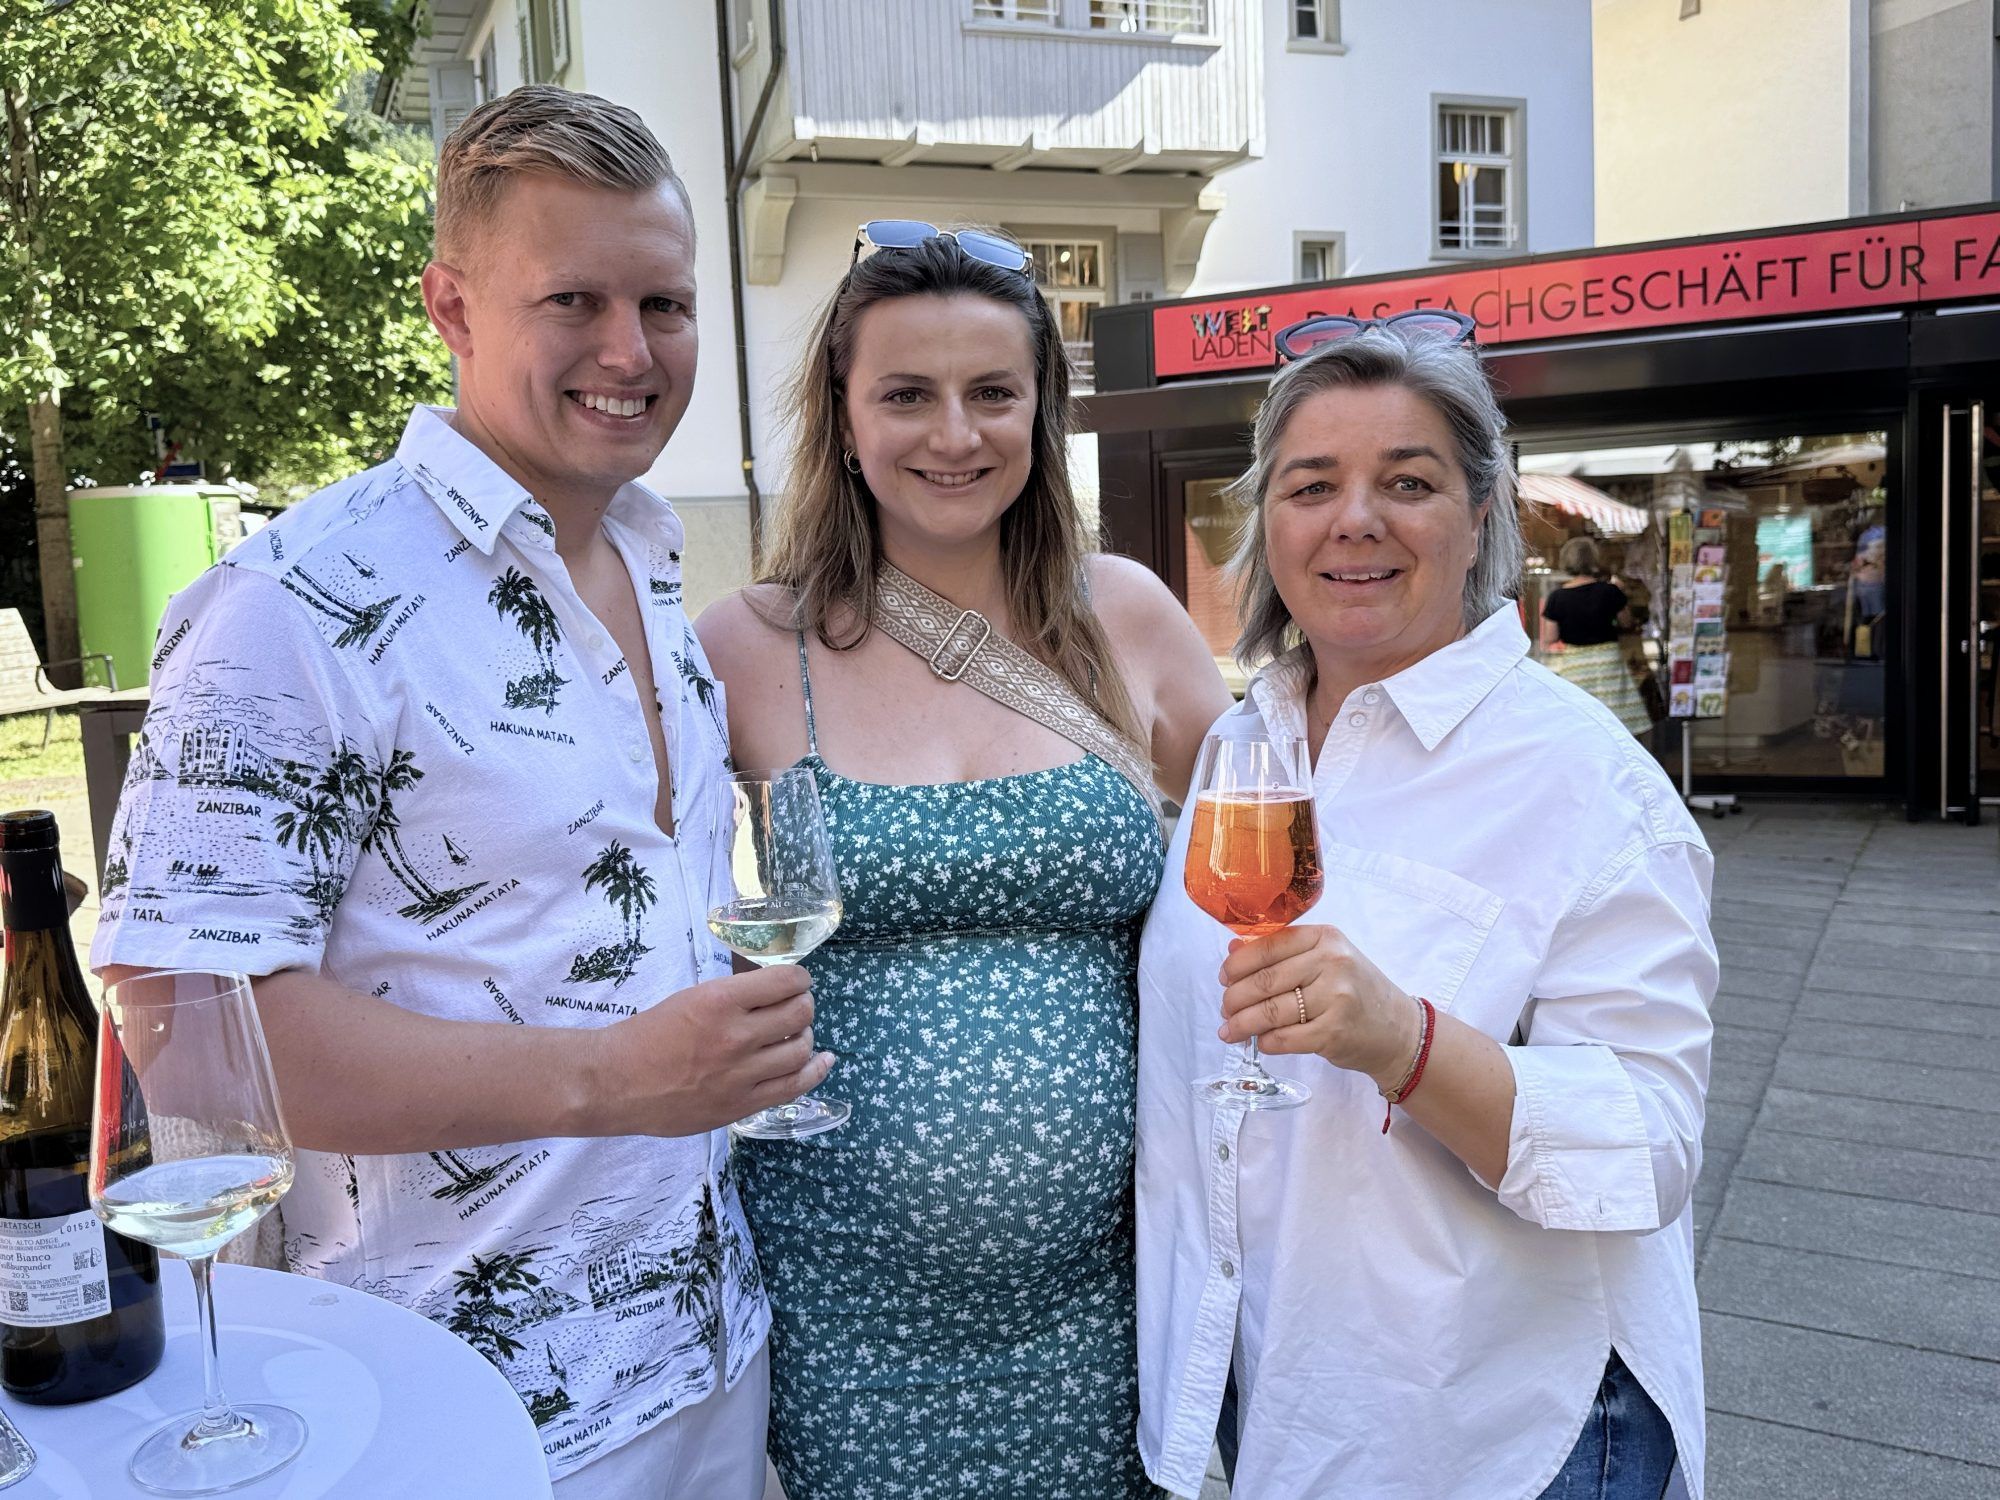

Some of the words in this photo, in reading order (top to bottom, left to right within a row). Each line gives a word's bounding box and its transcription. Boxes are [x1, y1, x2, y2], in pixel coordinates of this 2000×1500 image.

[1830, 236, 1927, 294] FÜR
[1191, 305, 1272, 337] WELT
[1192, 330, 1272, 361] LADEN
[446, 486, 489, 532] ZANZIBAR
[152, 618, 193, 670] ZANZIBAR
[425, 701, 476, 756] ZANZIBAR
[490, 720, 536, 738] HAKUNA
[536, 730, 576, 746] MATATA
[196, 800, 262, 818] ZANZIBAR
[567, 799, 605, 836] ZANZIBAR
[132, 908, 163, 922] TATA
[426, 905, 476, 942] HAKUNA
[474, 878, 521, 913] MATATA
[188, 928, 262, 945] ZANZIBAR
[545, 995, 594, 1012] HAKUNA
[593, 1002, 638, 1017] MATATA
[459, 1183, 505, 1221] HAKUNA
[506, 1149, 551, 1189] MATATA
[16, 1252, 51, 1262] Bianco
[615, 1296, 666, 1323] ZANZIBAR
[636, 1397, 675, 1426] ZANZIBAR
[573, 1415, 613, 1444] MATATA
